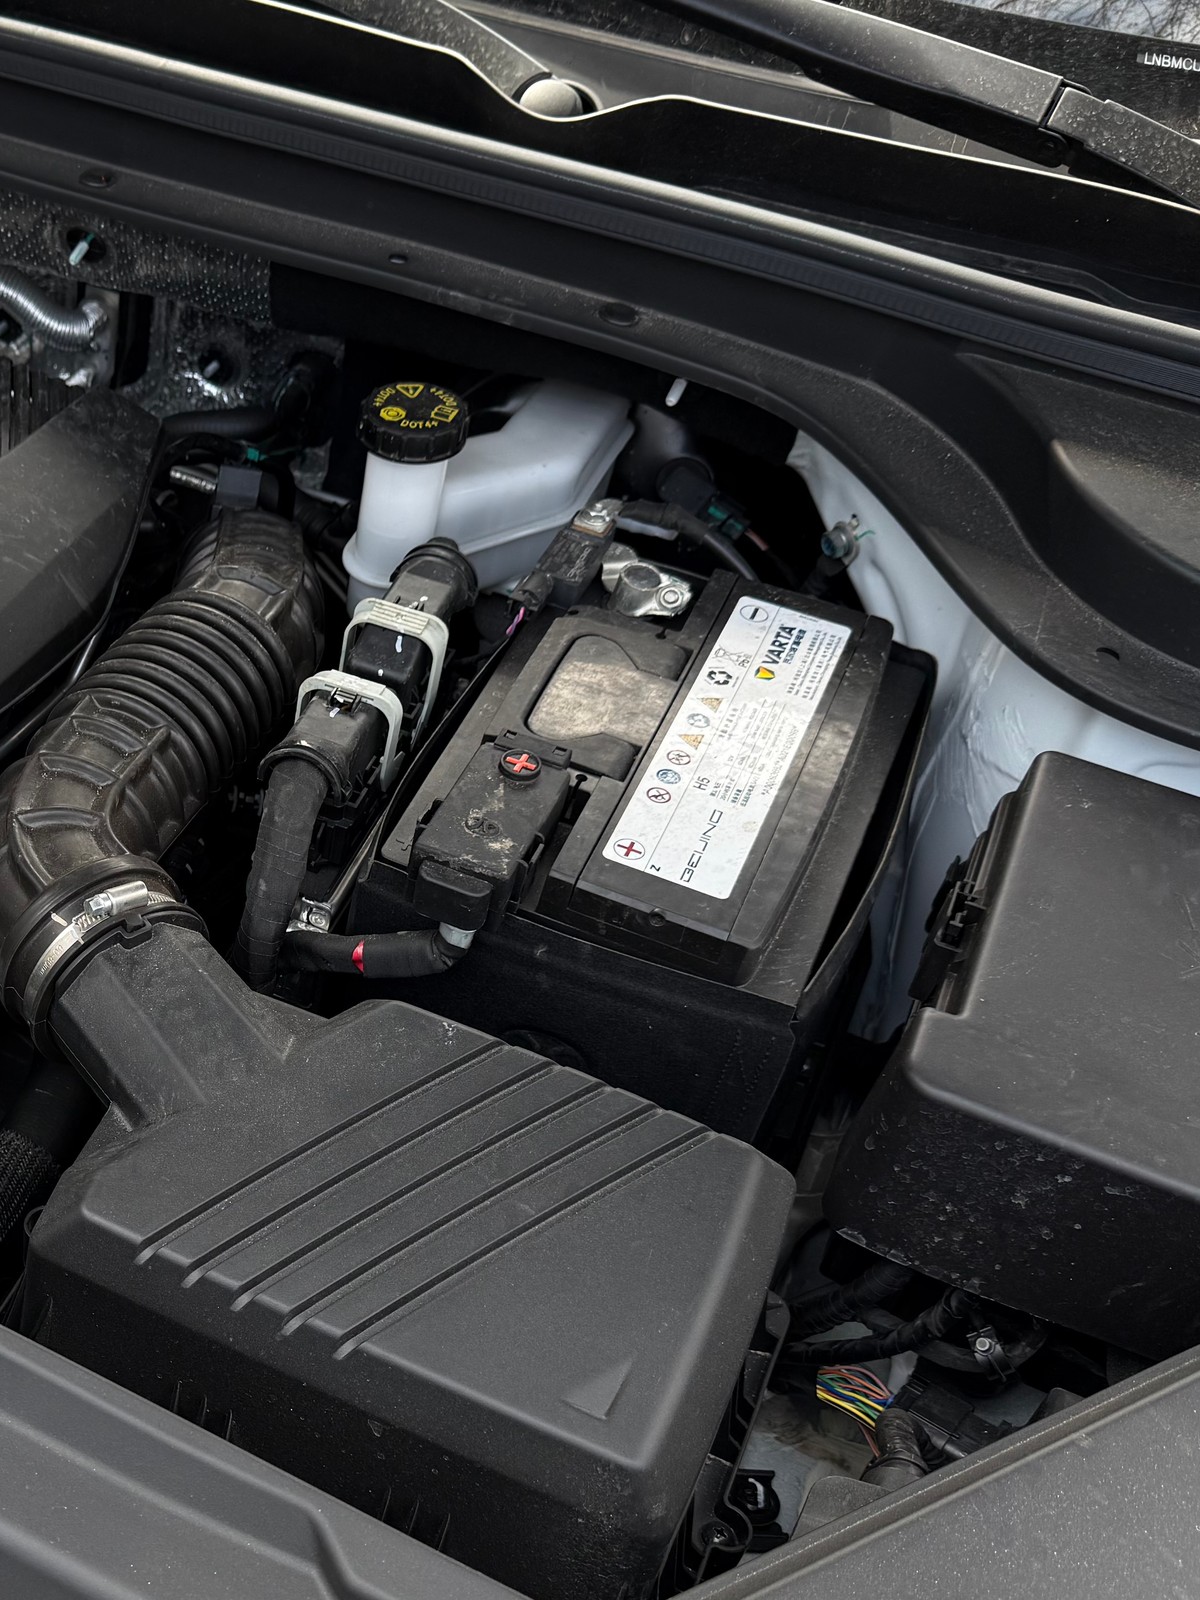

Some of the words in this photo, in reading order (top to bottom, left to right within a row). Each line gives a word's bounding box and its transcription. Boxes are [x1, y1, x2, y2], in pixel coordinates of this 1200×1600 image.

[761, 625, 797, 665] VARTA
[693, 776, 710, 791] H5
[680, 809, 723, 883] BEIJING
